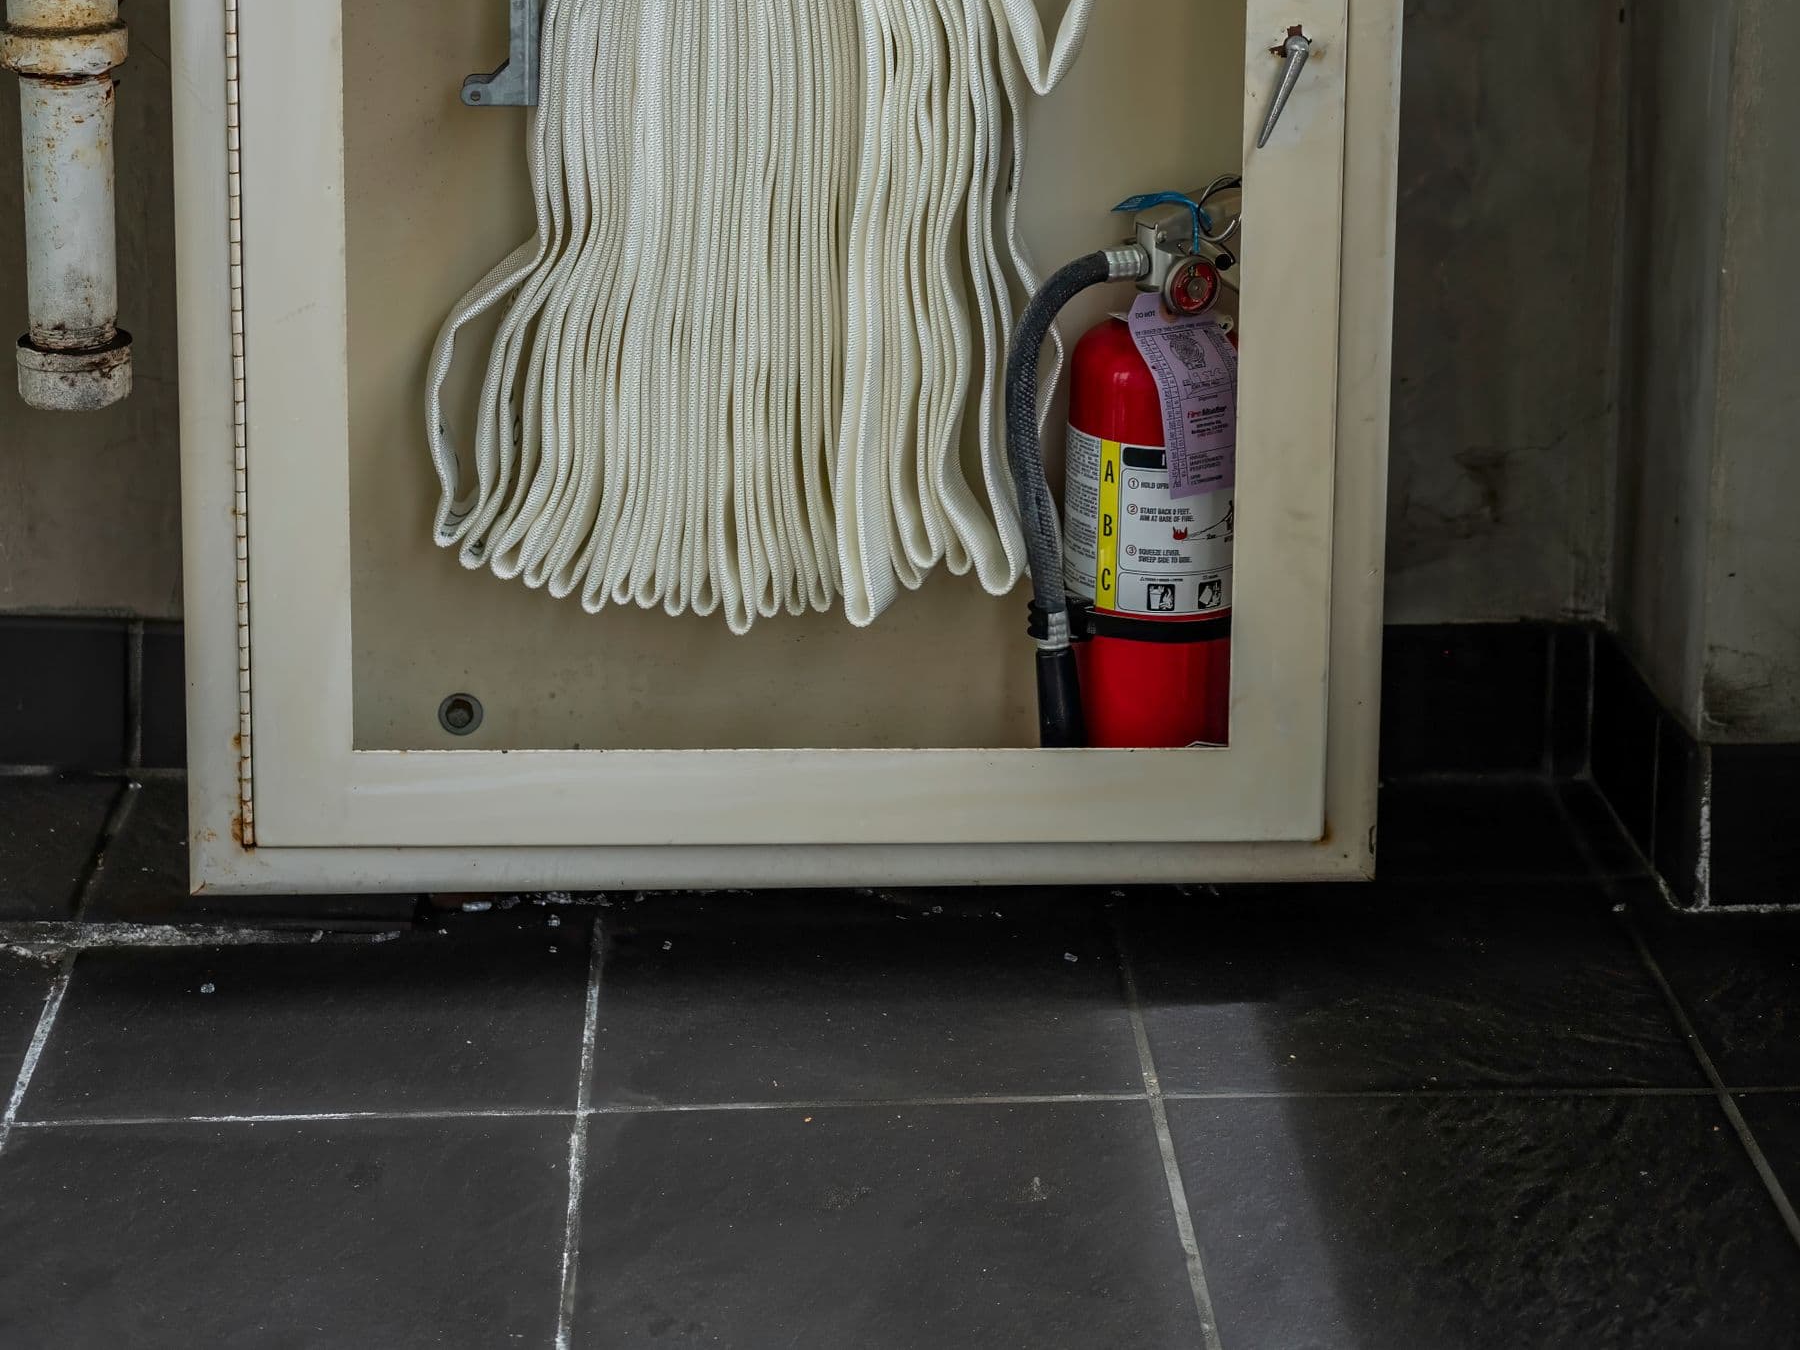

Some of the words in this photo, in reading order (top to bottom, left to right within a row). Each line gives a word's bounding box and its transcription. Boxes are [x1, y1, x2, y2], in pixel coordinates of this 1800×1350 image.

[1104, 460, 1114, 483] A
[1103, 514, 1113, 536] B
[1102, 568, 1111, 591] C
